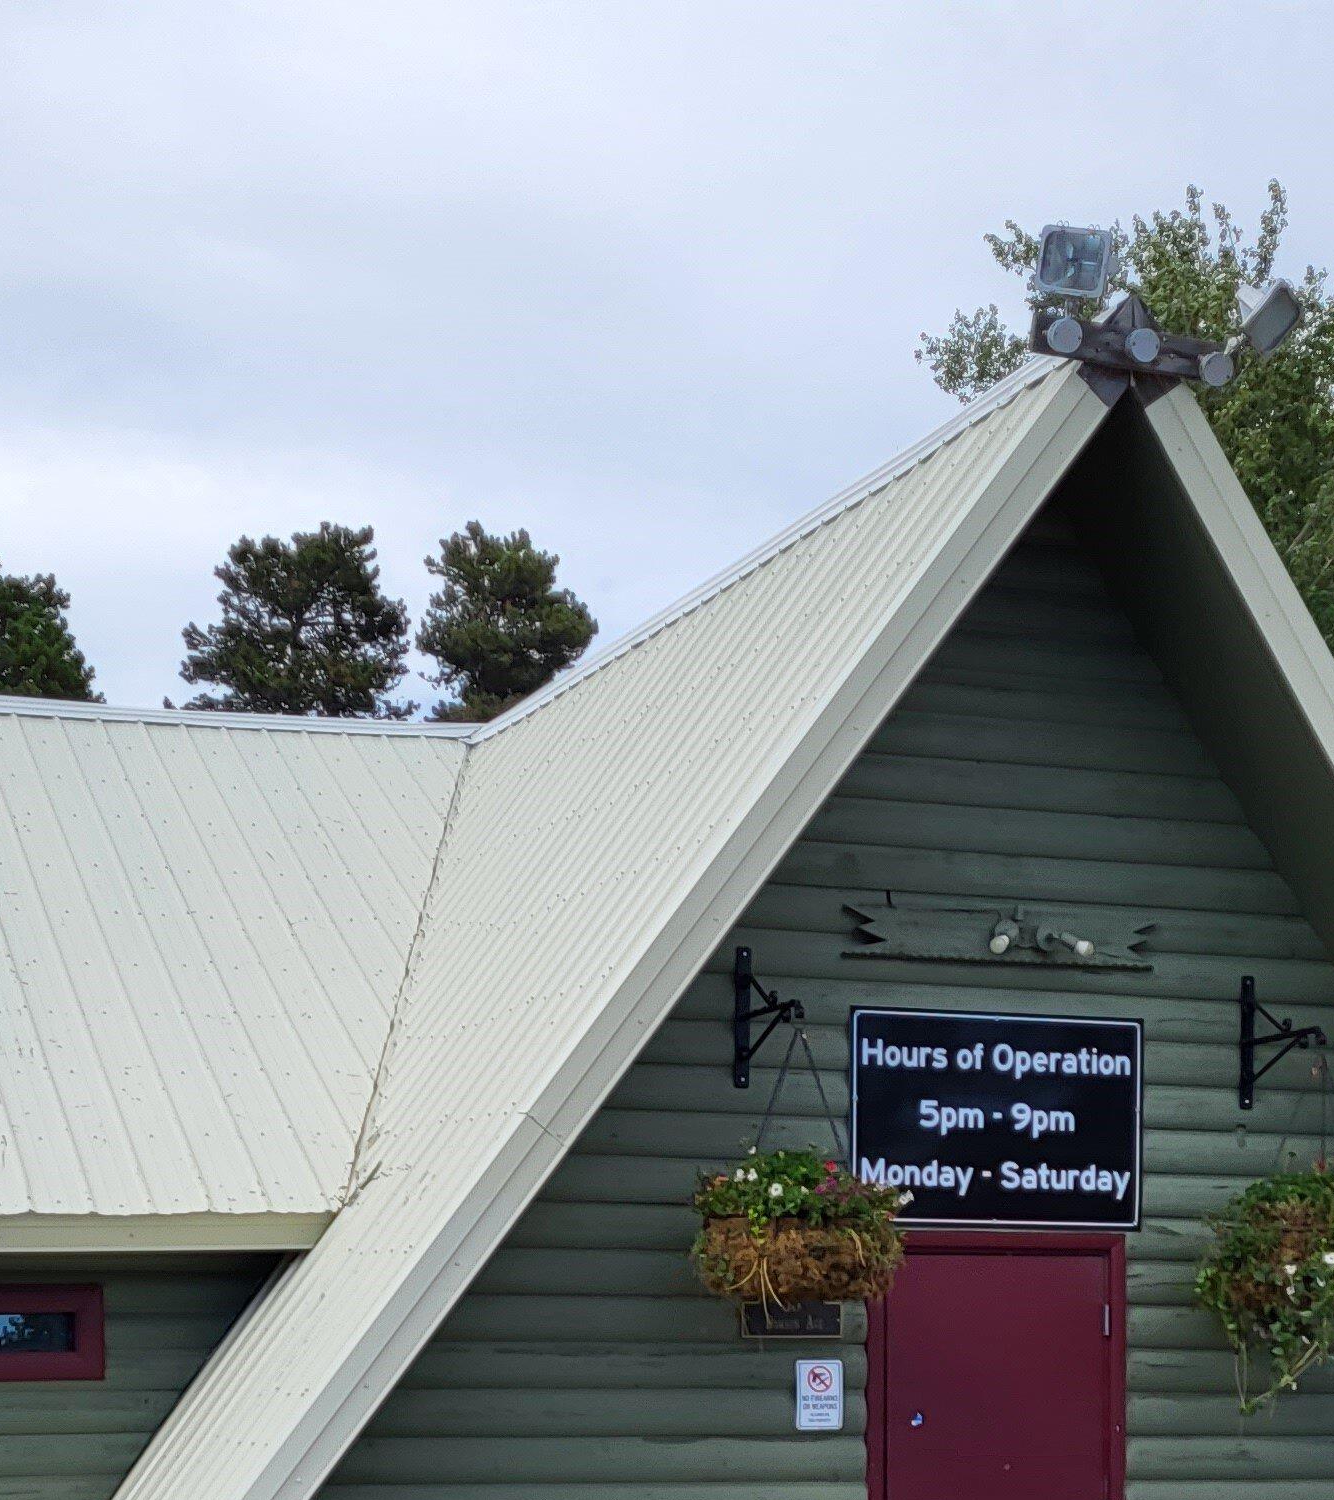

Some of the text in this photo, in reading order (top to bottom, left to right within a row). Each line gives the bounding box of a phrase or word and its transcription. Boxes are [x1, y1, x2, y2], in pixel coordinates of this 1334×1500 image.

[861, 1037, 1131, 1080] Hours of Operation
[919, 1099, 985, 1136] 5pm
[1010, 1102, 1075, 1139] 9pm
[861, 1157, 974, 1196] Monday
[1000, 1161, 1131, 1200] Saturday
